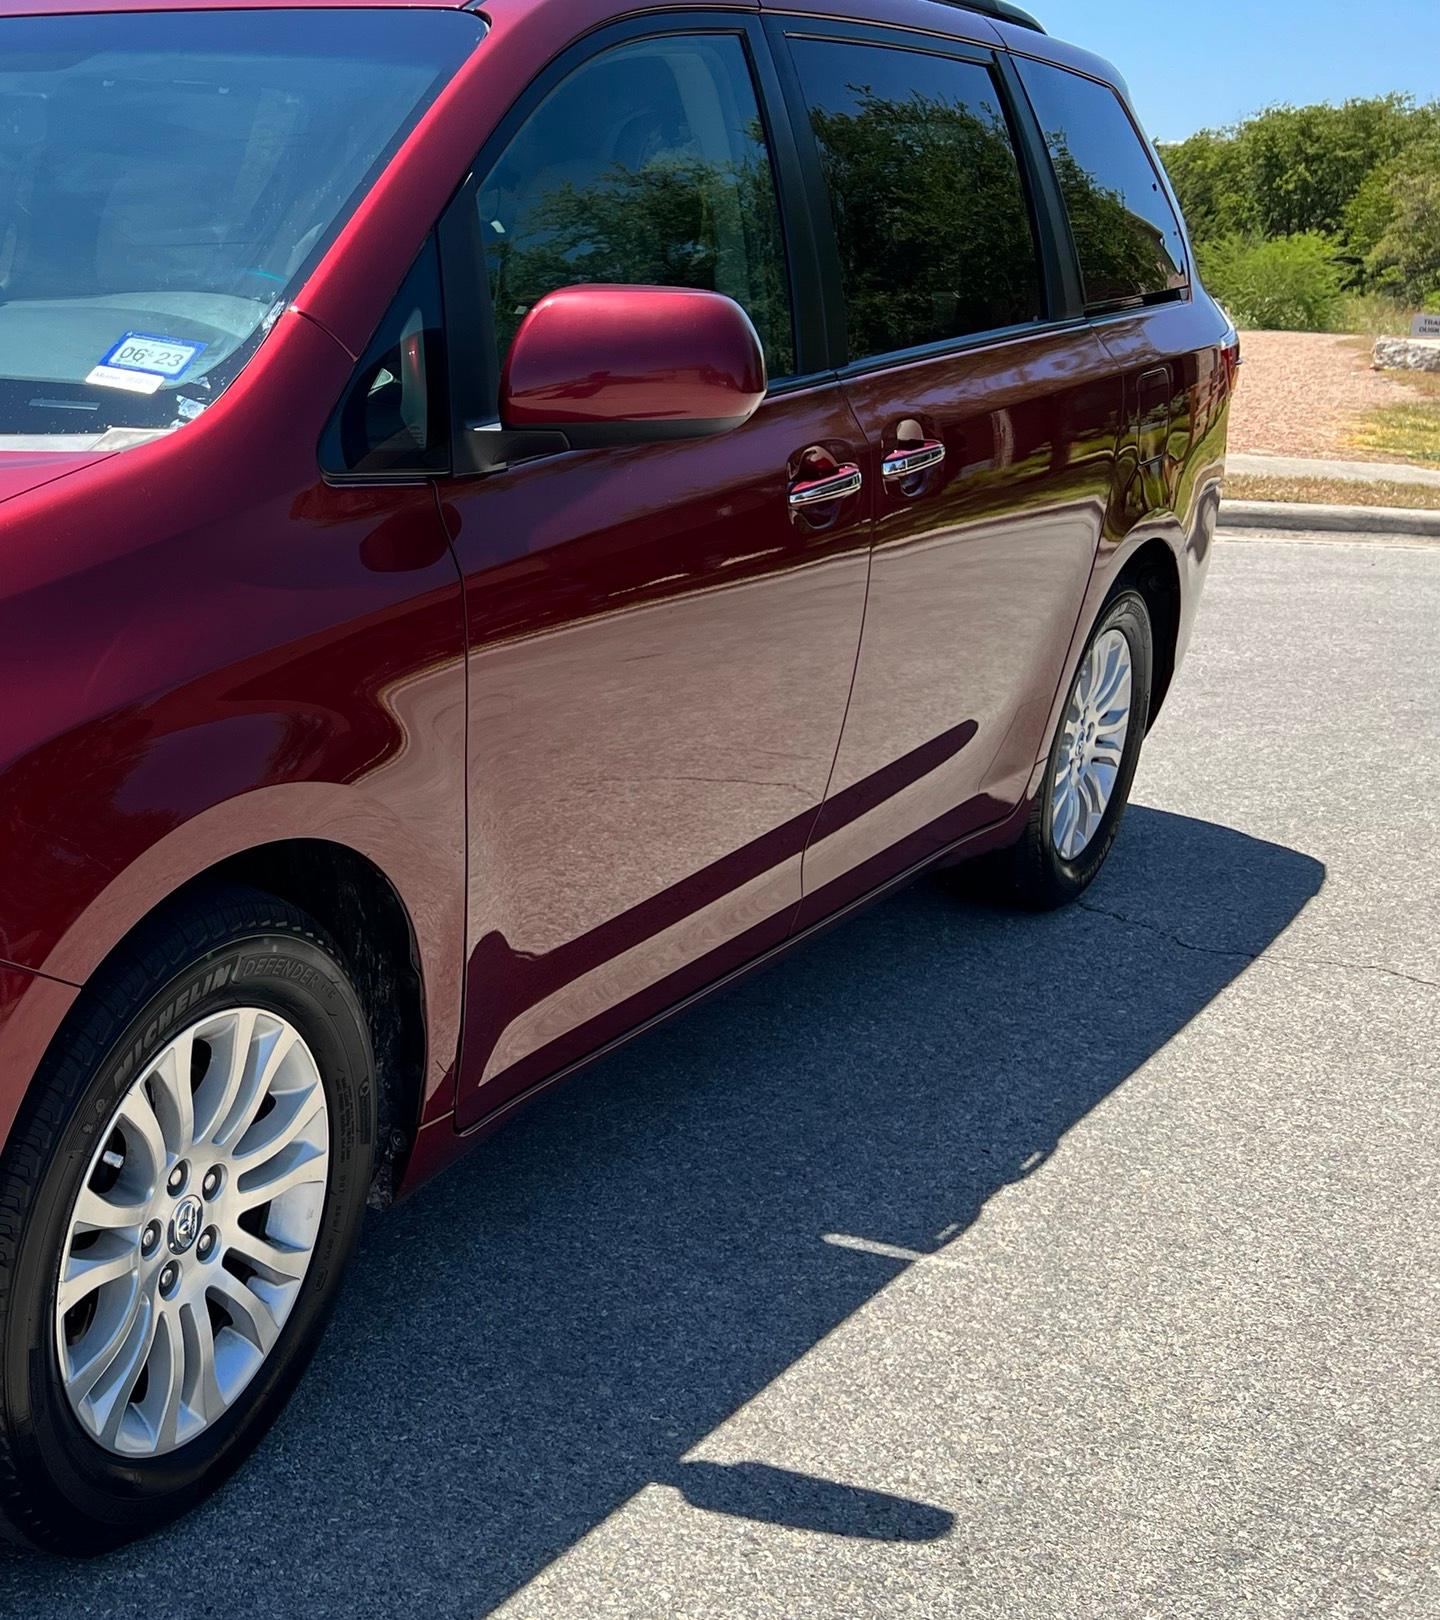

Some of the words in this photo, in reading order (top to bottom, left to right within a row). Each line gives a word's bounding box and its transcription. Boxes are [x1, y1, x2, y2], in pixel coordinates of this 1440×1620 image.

[120, 346, 148, 363] 06
[154, 351, 184, 367] 23
[113, 963, 232, 1090] MICHELIN
[243, 957, 323, 990] DEFENDER
